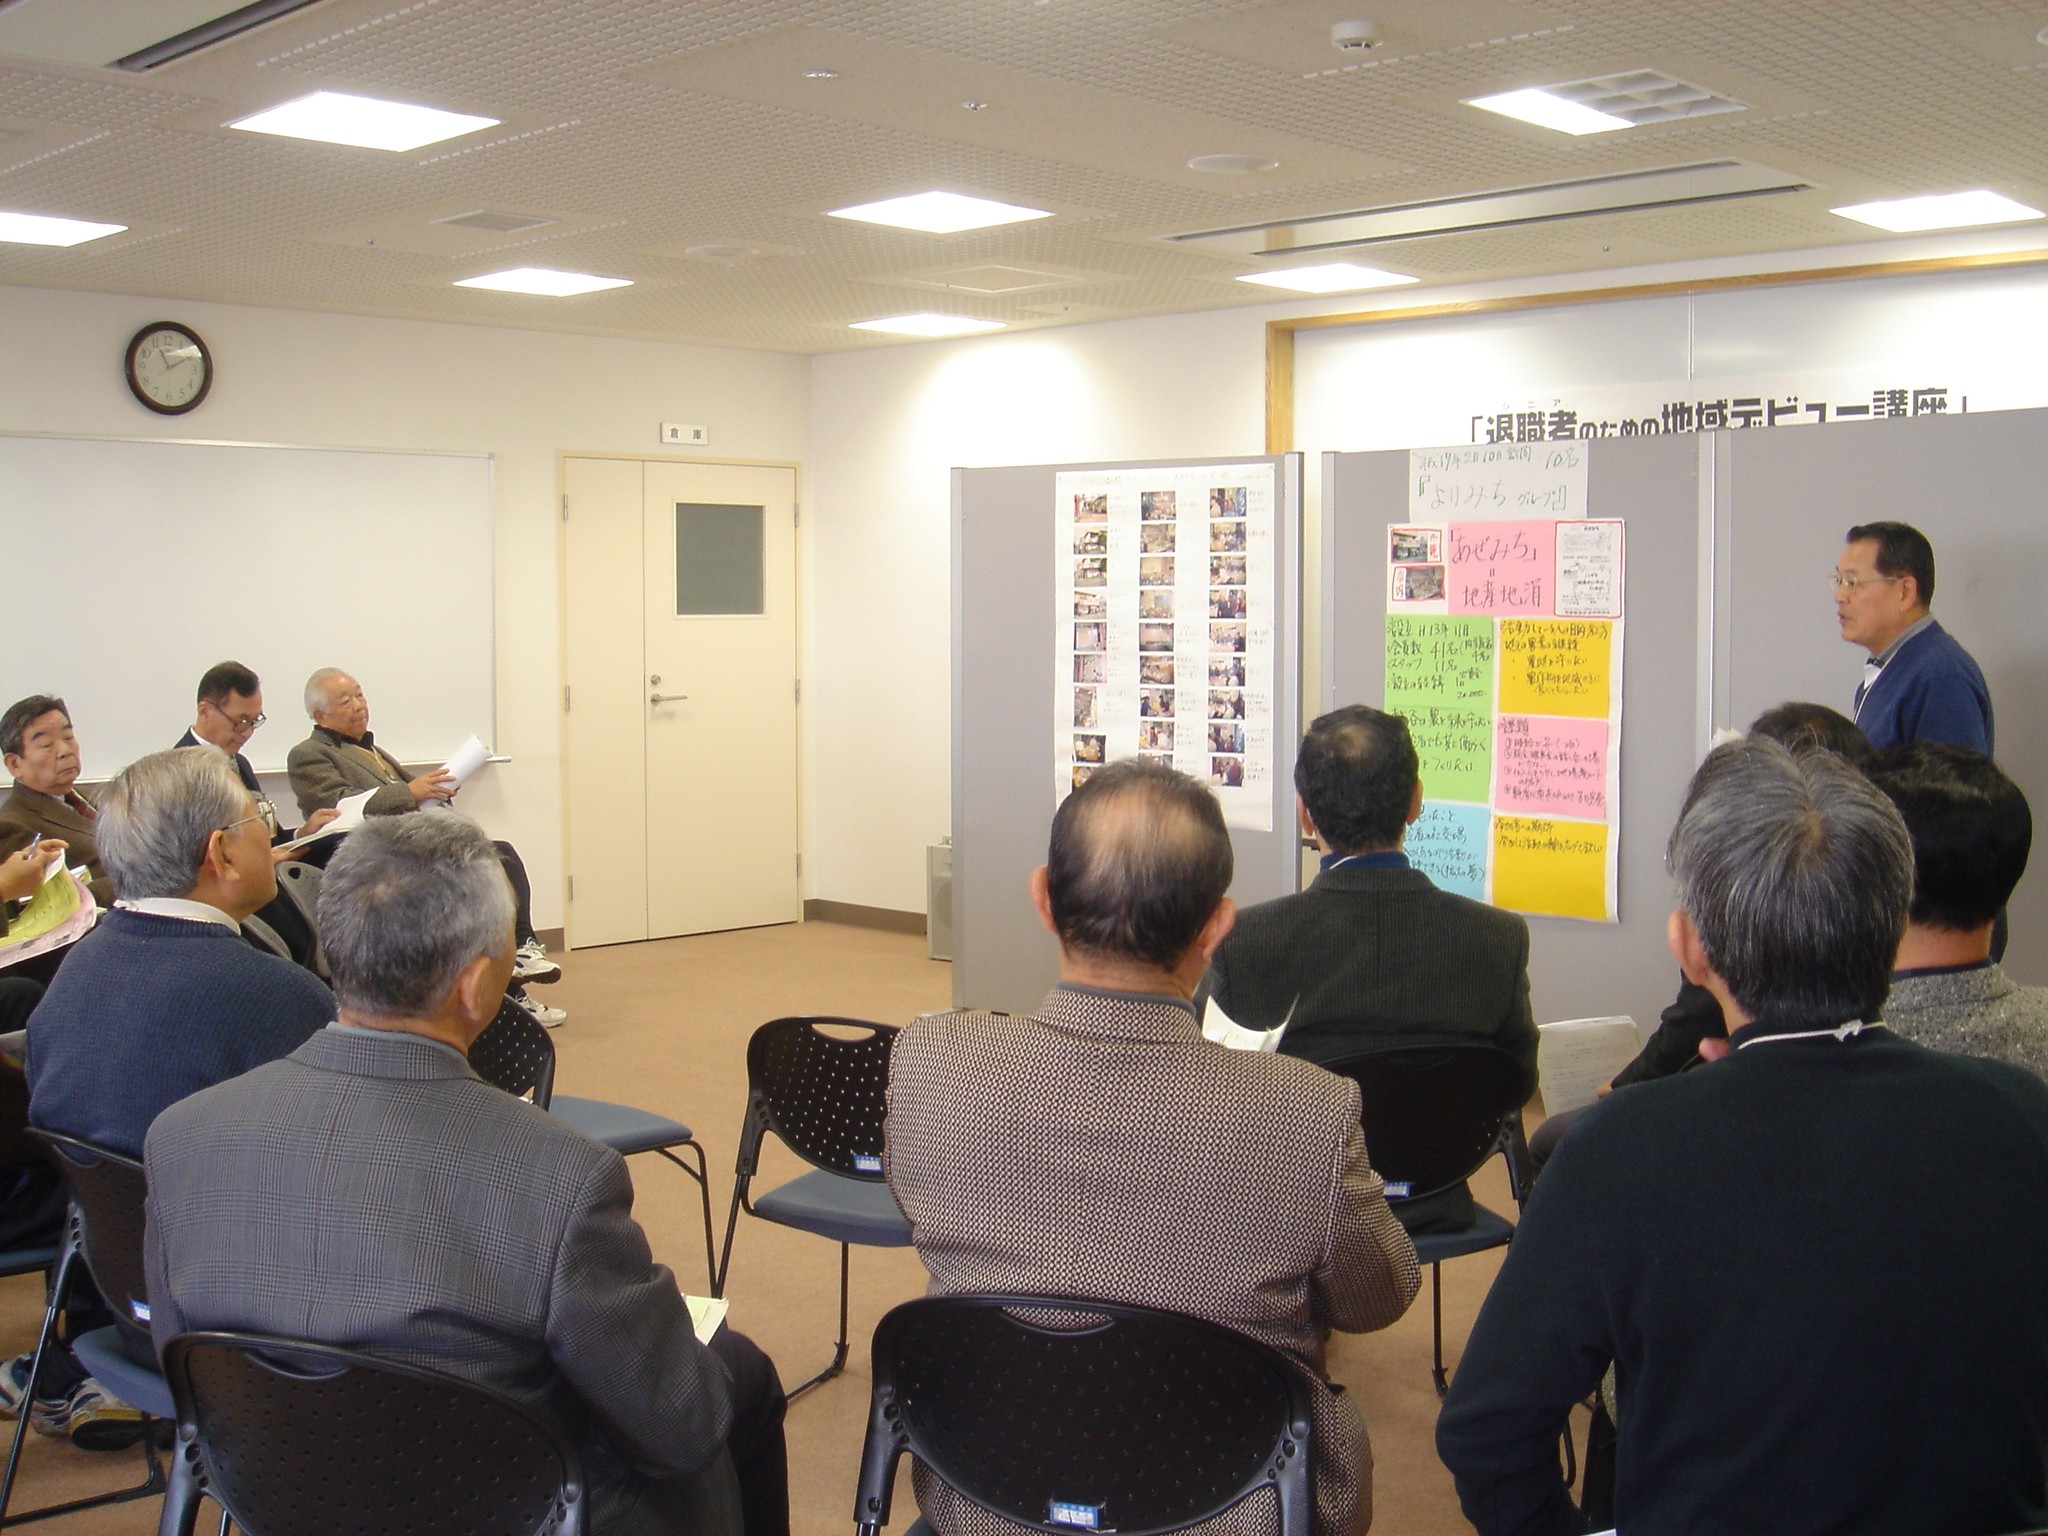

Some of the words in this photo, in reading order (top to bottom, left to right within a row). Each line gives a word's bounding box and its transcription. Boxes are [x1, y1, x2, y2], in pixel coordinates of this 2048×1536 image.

[1450, 527, 1537, 564] 「あぜみち」
[1463, 578, 1542, 608] 地産地消
